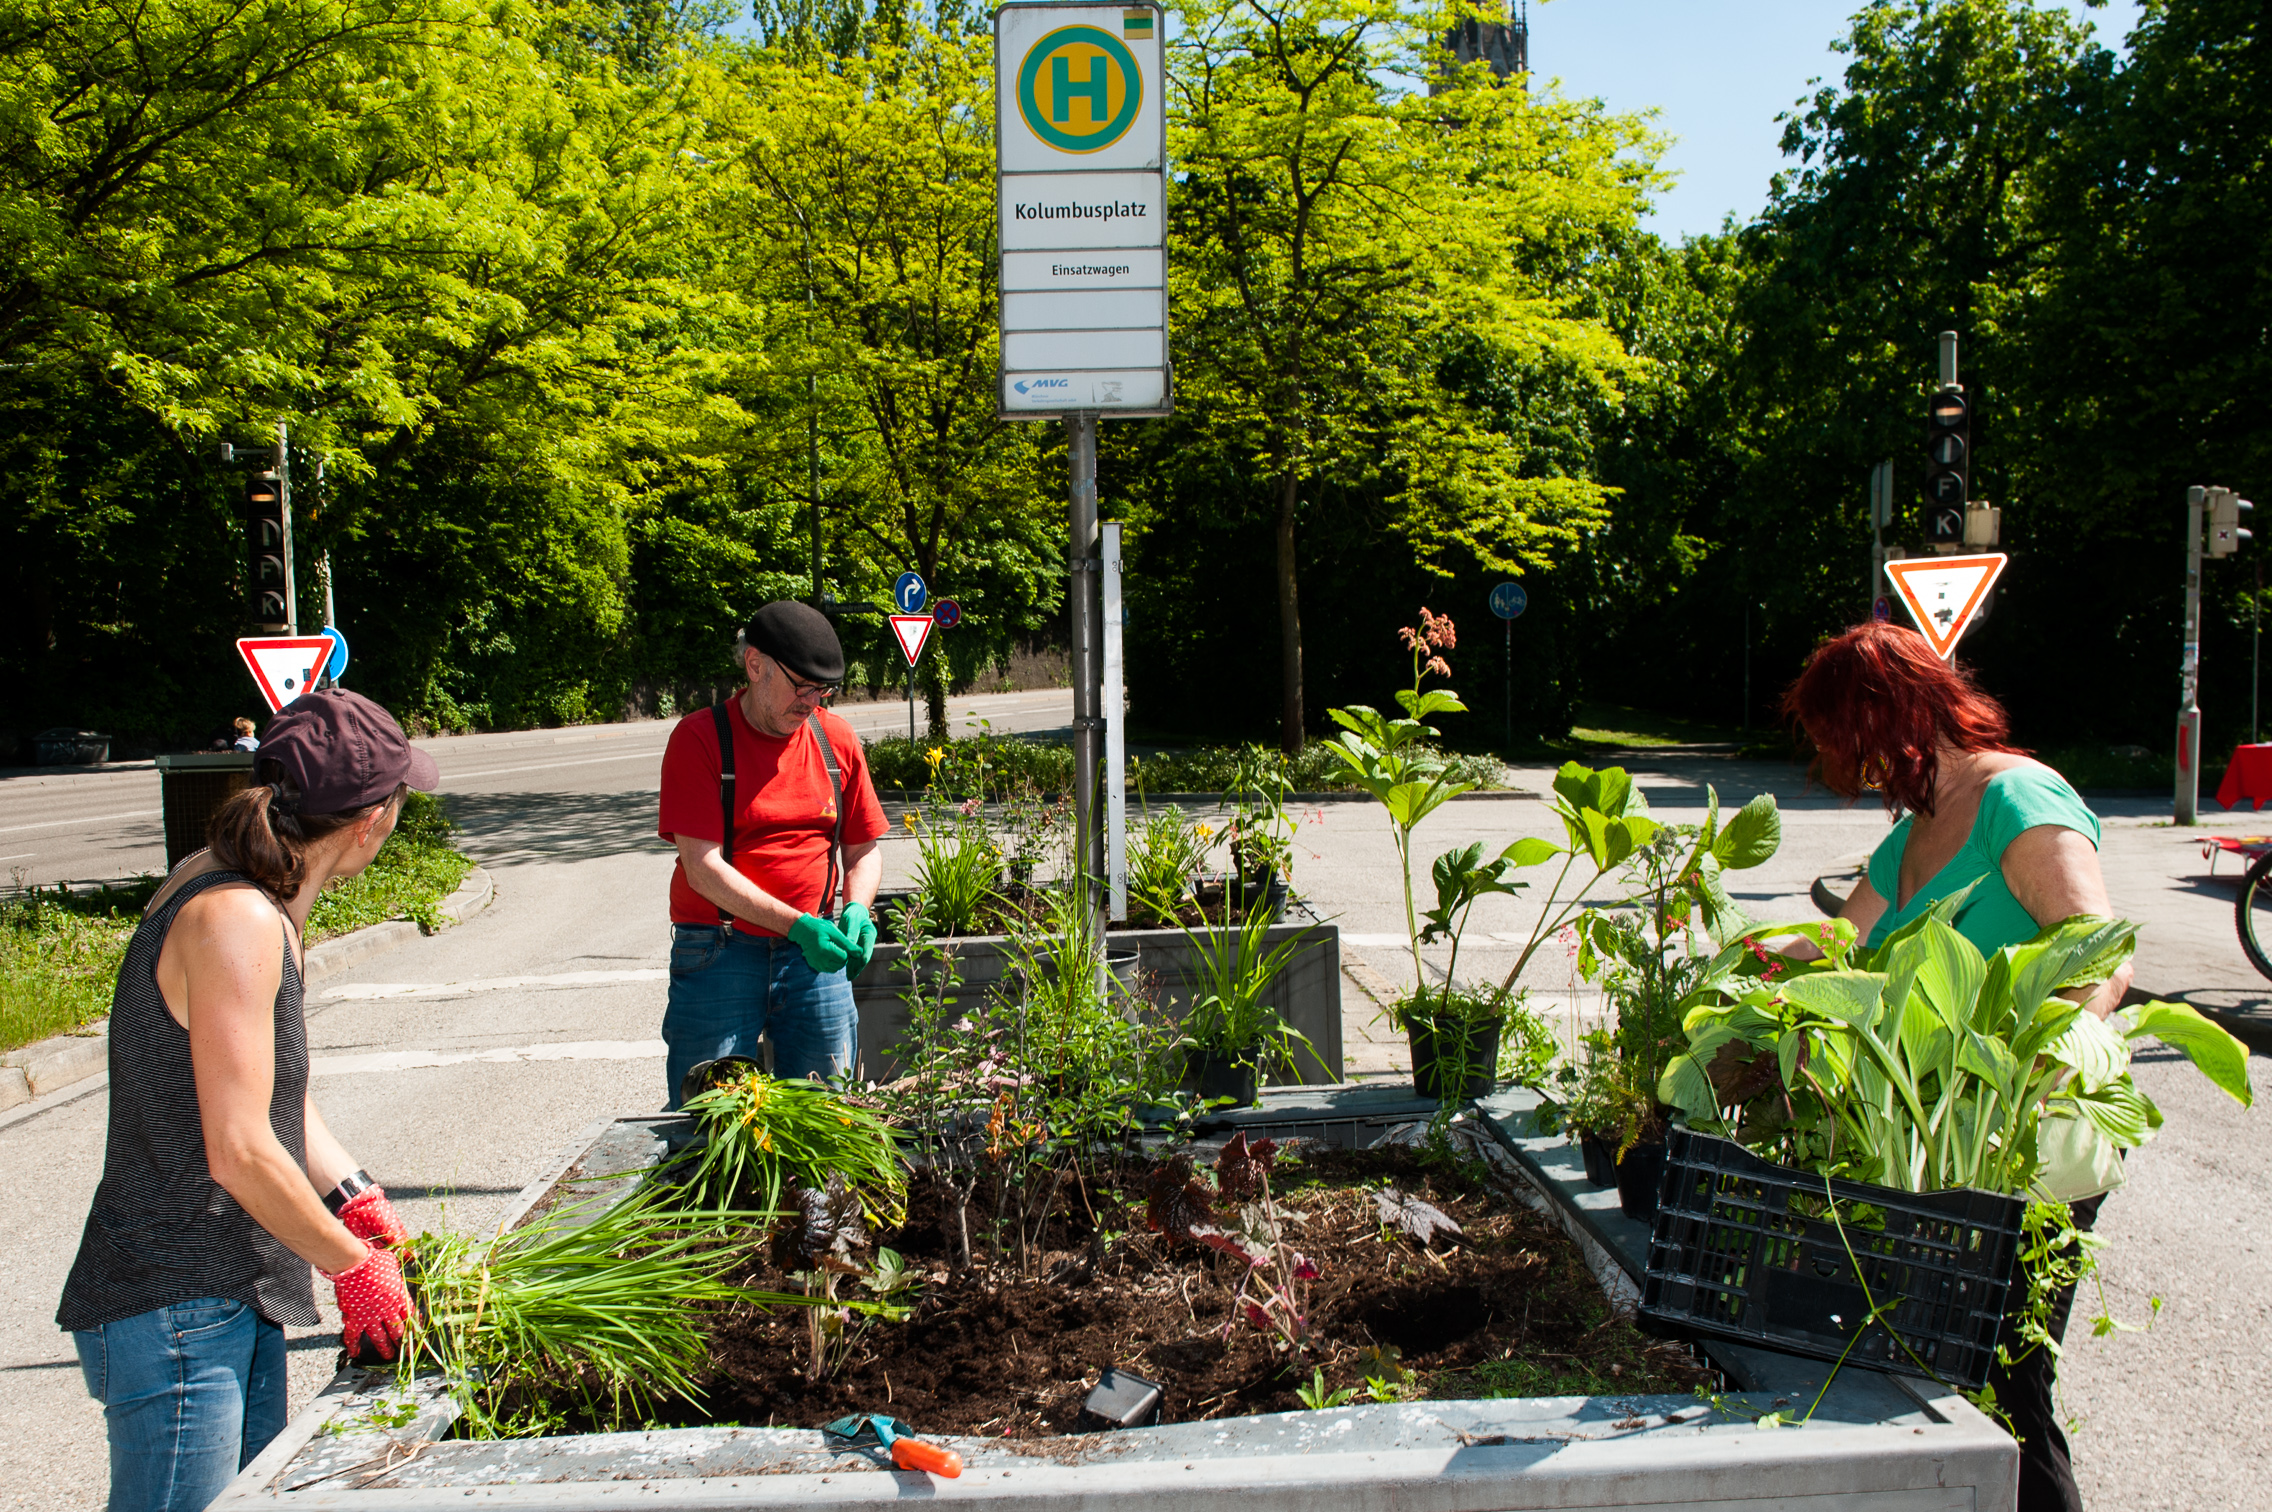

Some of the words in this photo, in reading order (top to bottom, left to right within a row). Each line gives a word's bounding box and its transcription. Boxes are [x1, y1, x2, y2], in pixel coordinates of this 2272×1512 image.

[1051, 55, 1108, 123] H
[1014, 200, 1147, 222] Kolumbusplatz
[1051, 263, 1130, 279] Einsatzwagen
[1031, 379, 1068, 388] MVG
[1936, 514, 1953, 535] K
[261, 596, 277, 616] K
